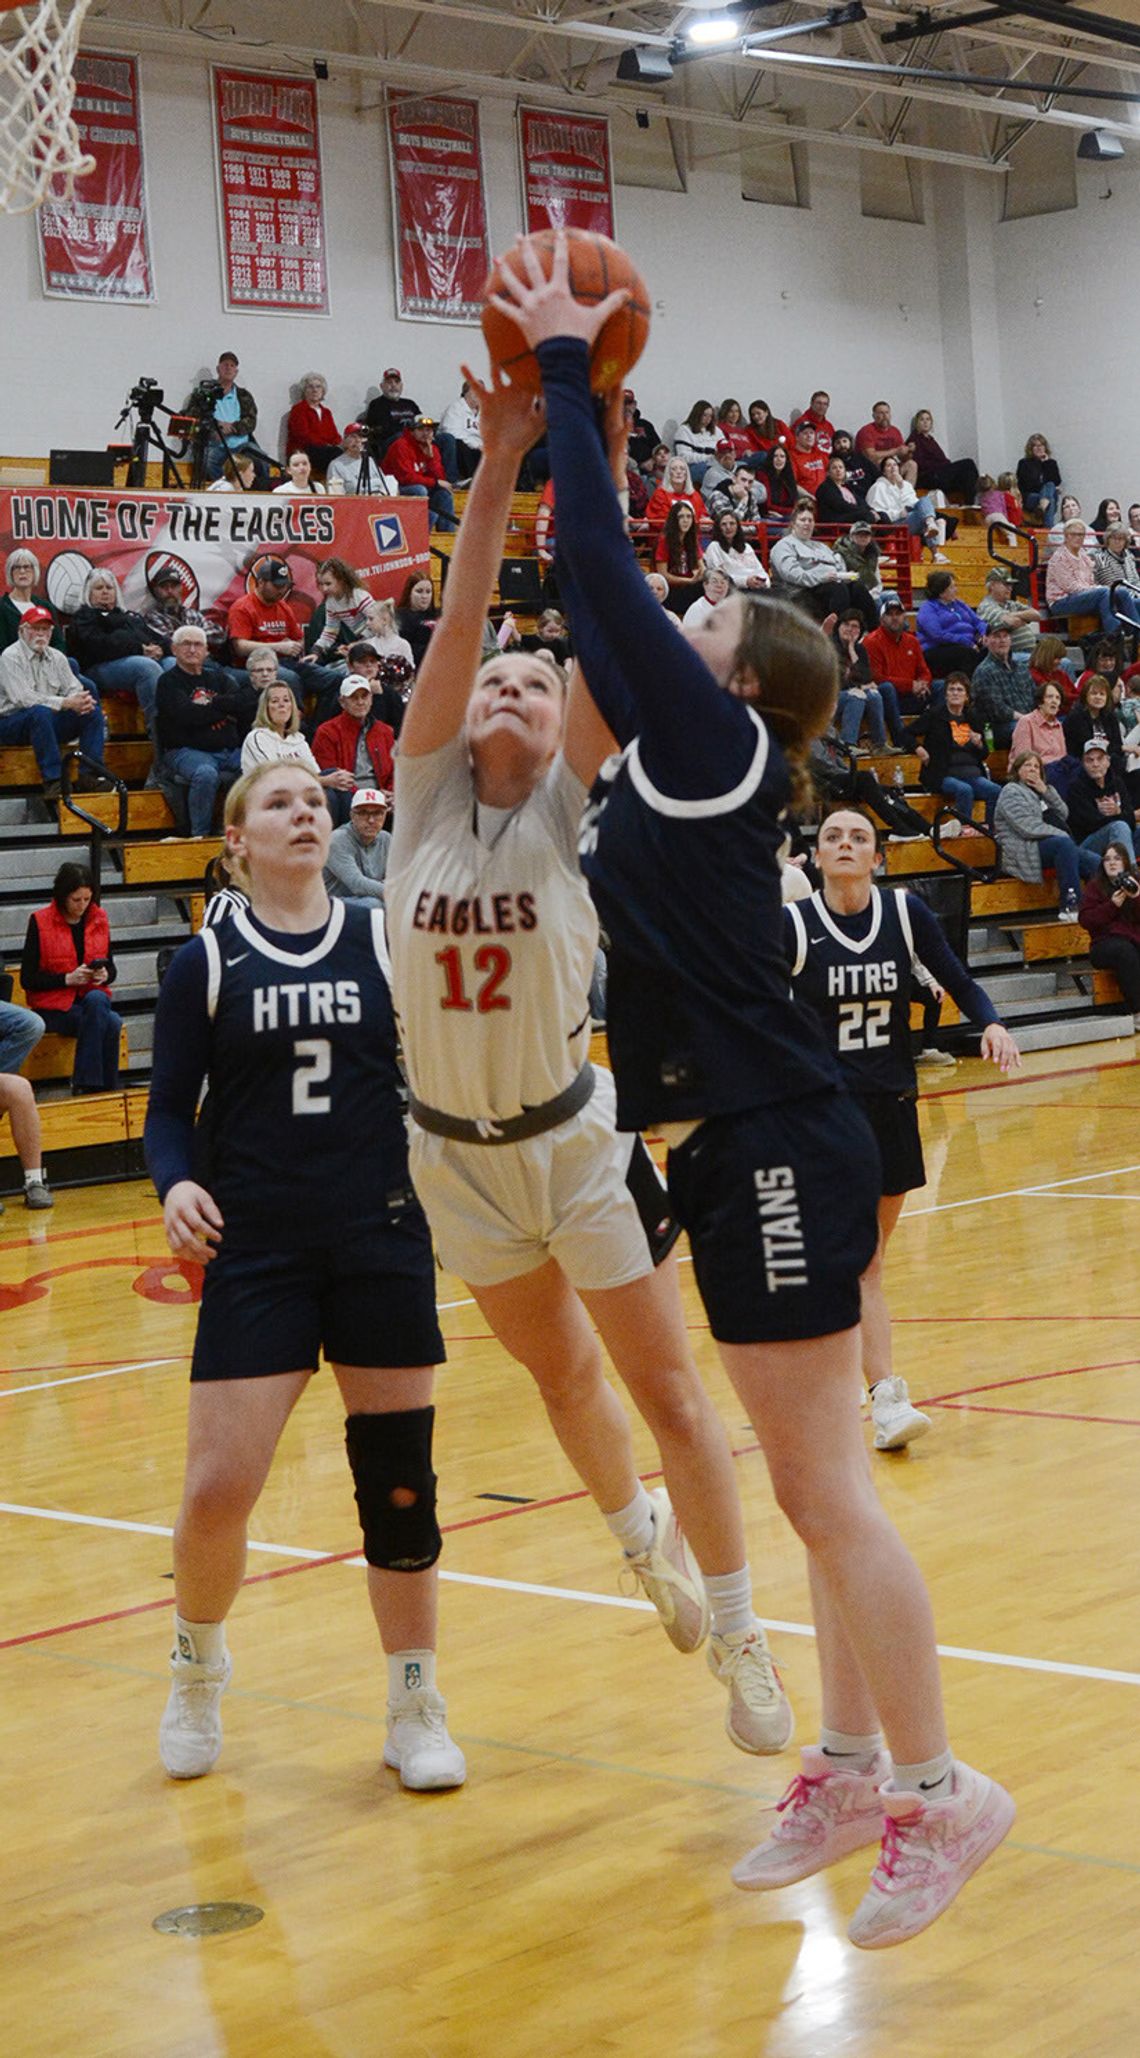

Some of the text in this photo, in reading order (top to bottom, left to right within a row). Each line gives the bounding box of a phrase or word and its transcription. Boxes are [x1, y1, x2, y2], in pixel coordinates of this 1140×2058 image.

[11, 496, 334, 544] HOME OF THE EAGLES
[365, 791, 376, 801] N
[412, 889, 538, 937] EAGLES
[434, 943, 512, 1014] 12
[827, 960, 899, 997] HTRS
[254, 980, 362, 1033] HTRS
[837, 1000, 892, 1051] 22
[292, 1038, 332, 1116] 2
[754, 1165, 808, 1293] TITANS
